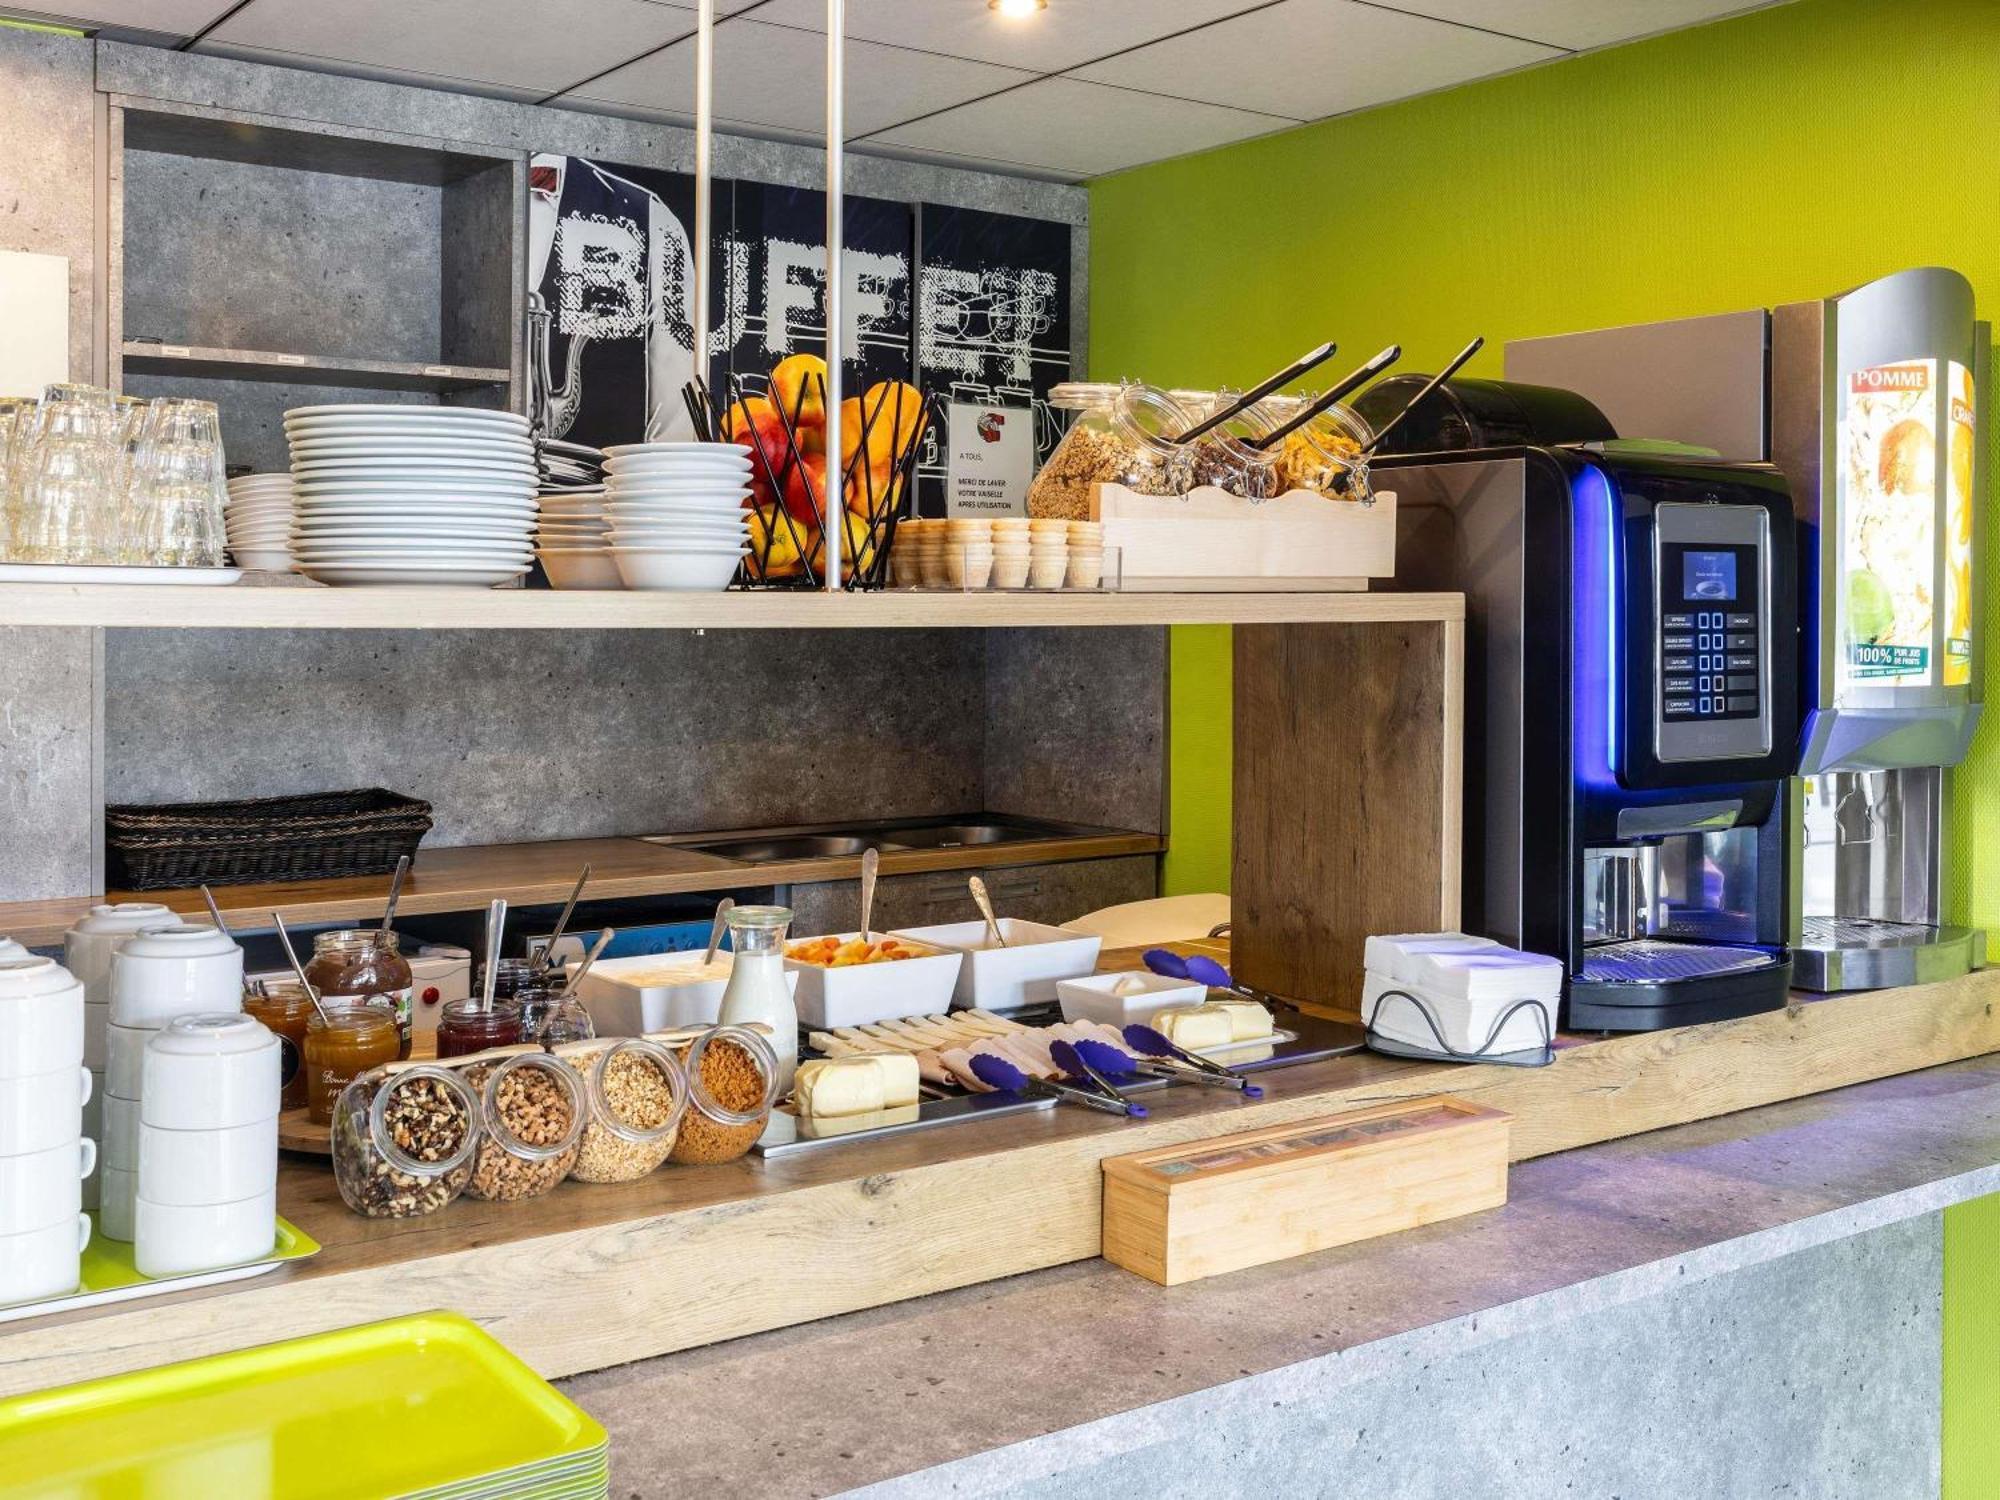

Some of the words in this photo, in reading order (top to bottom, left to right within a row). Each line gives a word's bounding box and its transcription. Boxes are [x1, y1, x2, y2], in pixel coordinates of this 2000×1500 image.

[556, 211, 1058, 381] BUFFET
[1856, 370, 1925, 388] POMME
[1857, 647, 1892, 664] 100%
